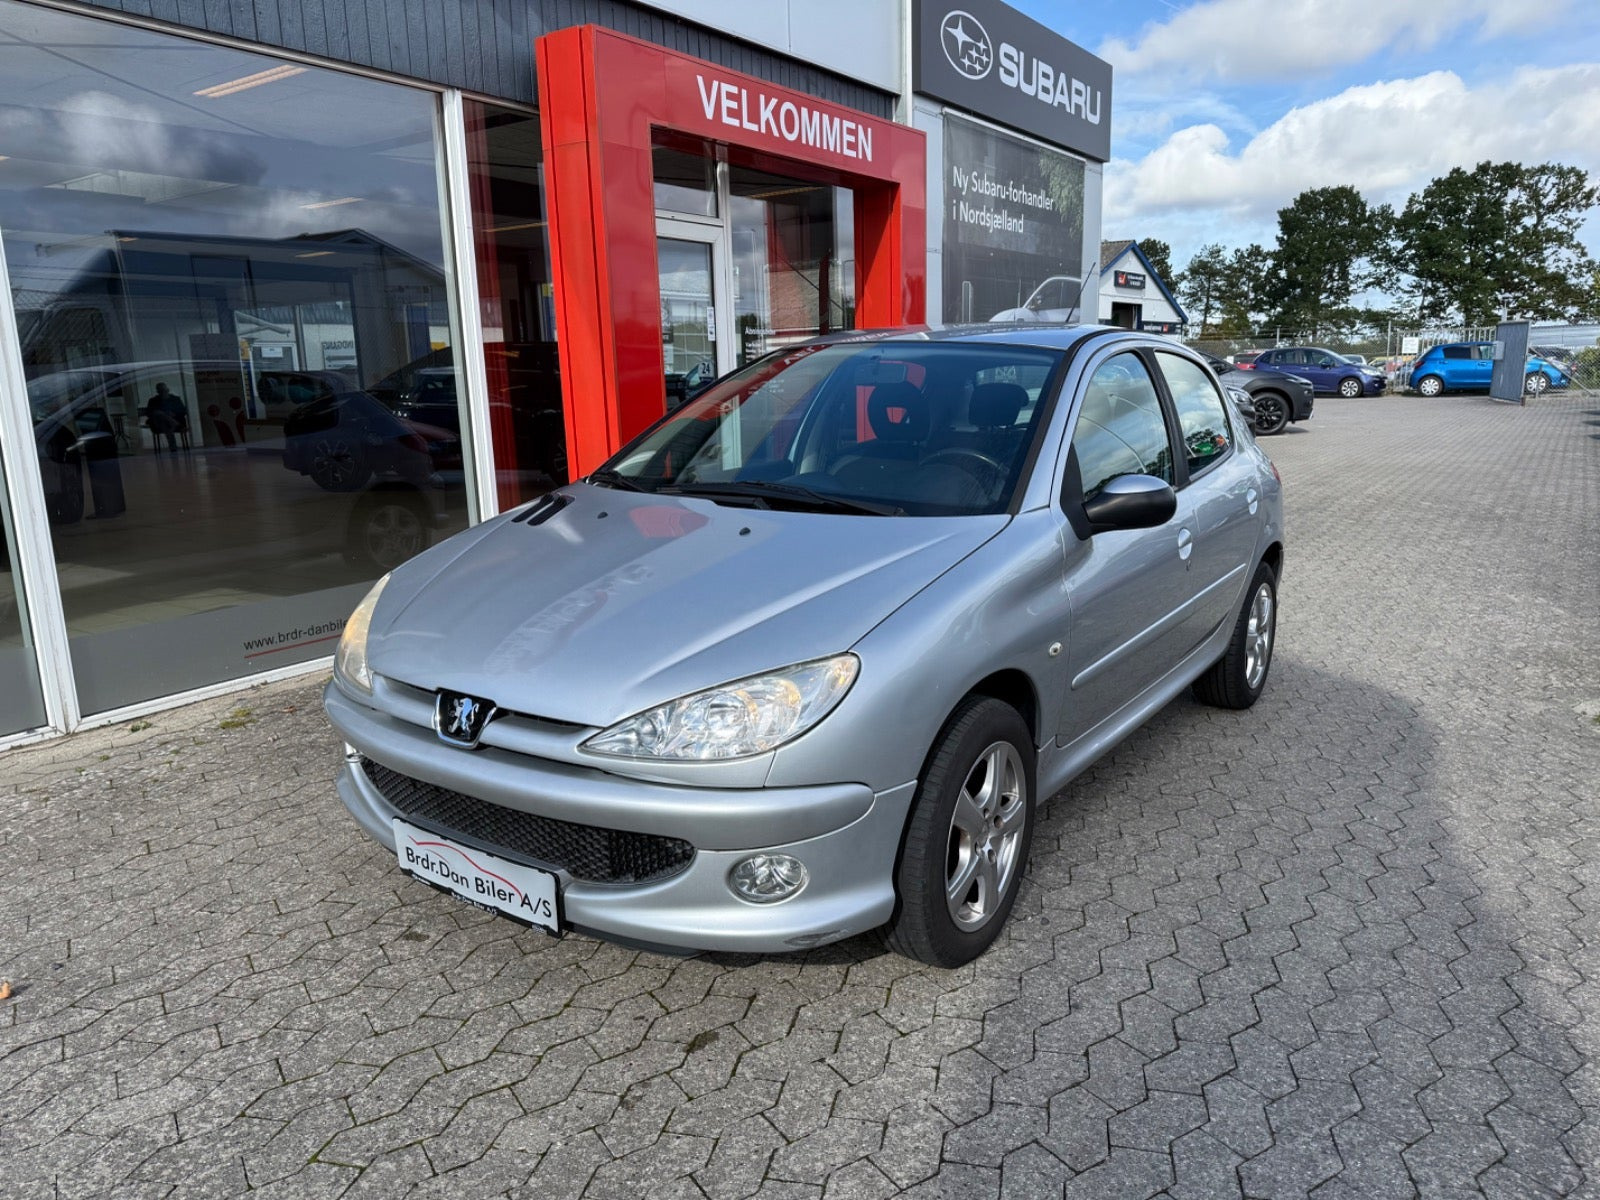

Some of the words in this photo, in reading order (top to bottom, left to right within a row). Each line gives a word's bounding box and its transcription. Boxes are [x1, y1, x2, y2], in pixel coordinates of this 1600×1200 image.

[999, 42, 1101, 125] SUBARU
[696, 75, 873, 162] VELKOMMEN
[953, 165, 969, 196] Ny
[971, 171, 1054, 211] Subaru-forhandler
[952, 199, 957, 220] i
[959, 200, 1025, 234] Nordsjælland
[474, 876, 515, 904] Biler
[520, 893, 552, 918] A/S
